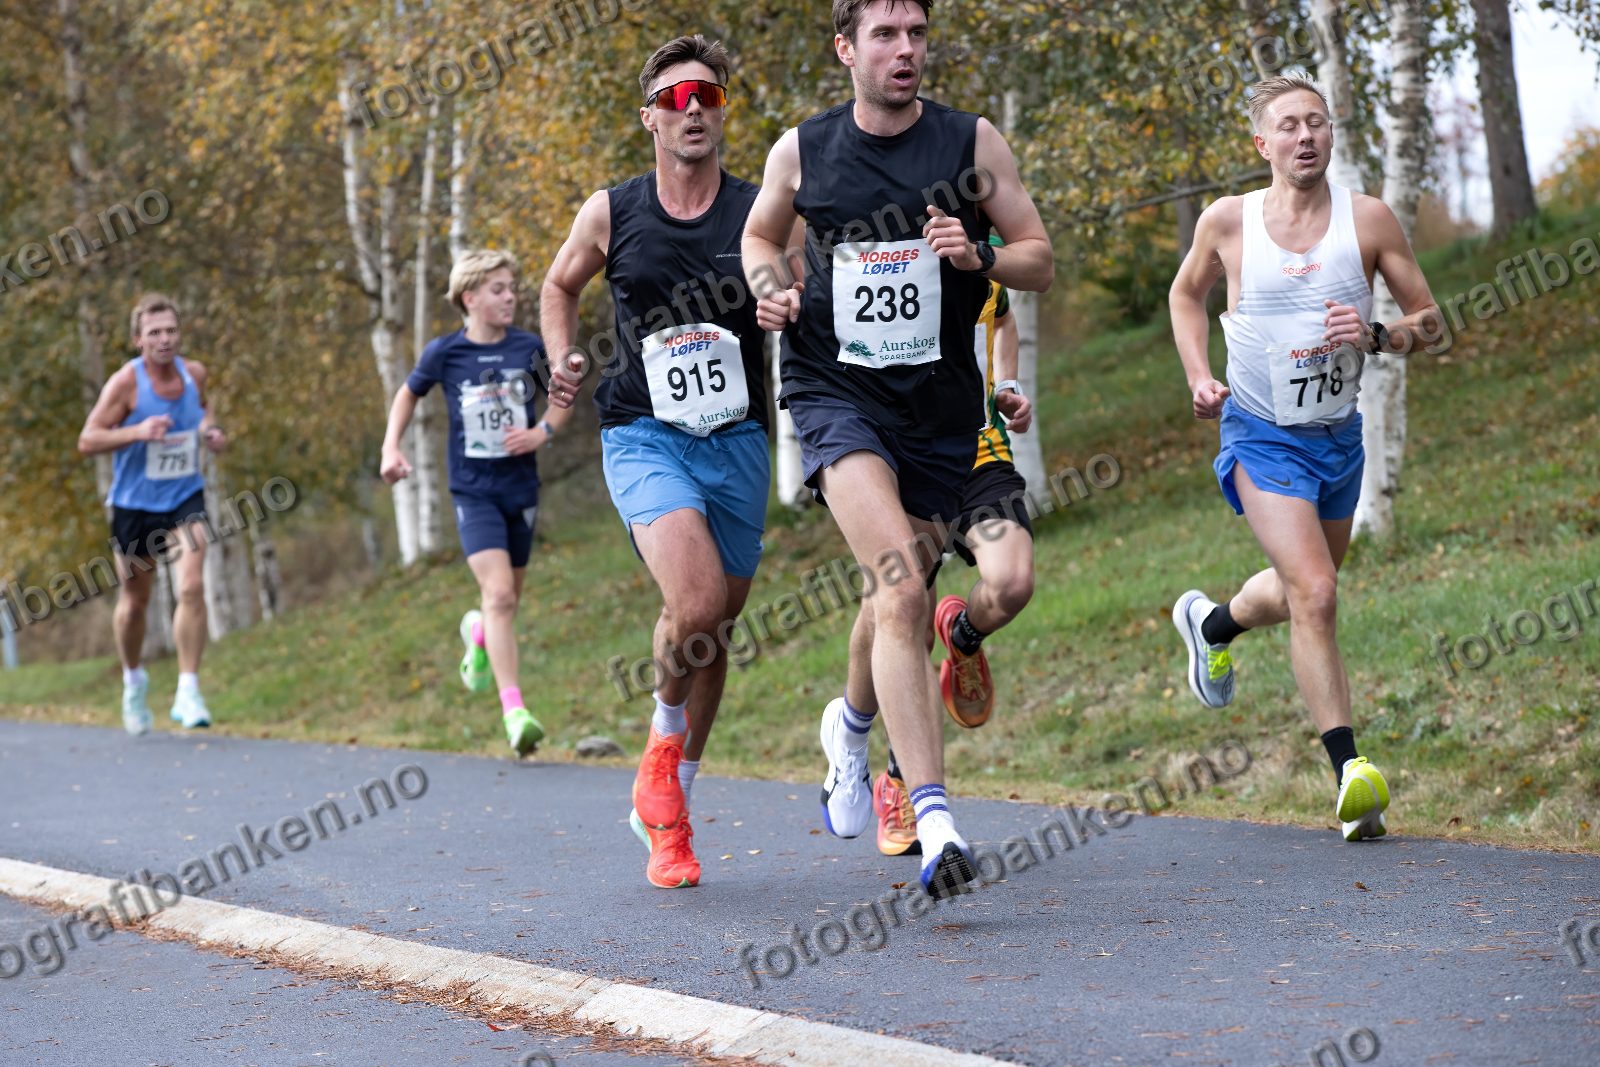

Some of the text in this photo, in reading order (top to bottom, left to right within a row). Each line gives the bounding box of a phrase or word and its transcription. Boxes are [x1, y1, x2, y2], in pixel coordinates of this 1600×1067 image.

[858, 249, 920, 263] NORGES
[862, 262, 910, 275] LØPET
[1281, 262, 1322, 275] saucony
[855, 283, 920, 322] 238
[664, 331, 721, 348] NORGES
[879, 336, 936, 353] Aurskog
[671, 341, 711, 358] LØPET
[879, 350, 927, 361] SPAREBANK
[1289, 340, 1343, 360] NORGES
[667, 359, 726, 402] 915
[1290, 367, 1343, 407] 778
[477, 408, 514, 432] 193
[698, 406, 746, 426] Aurskog
